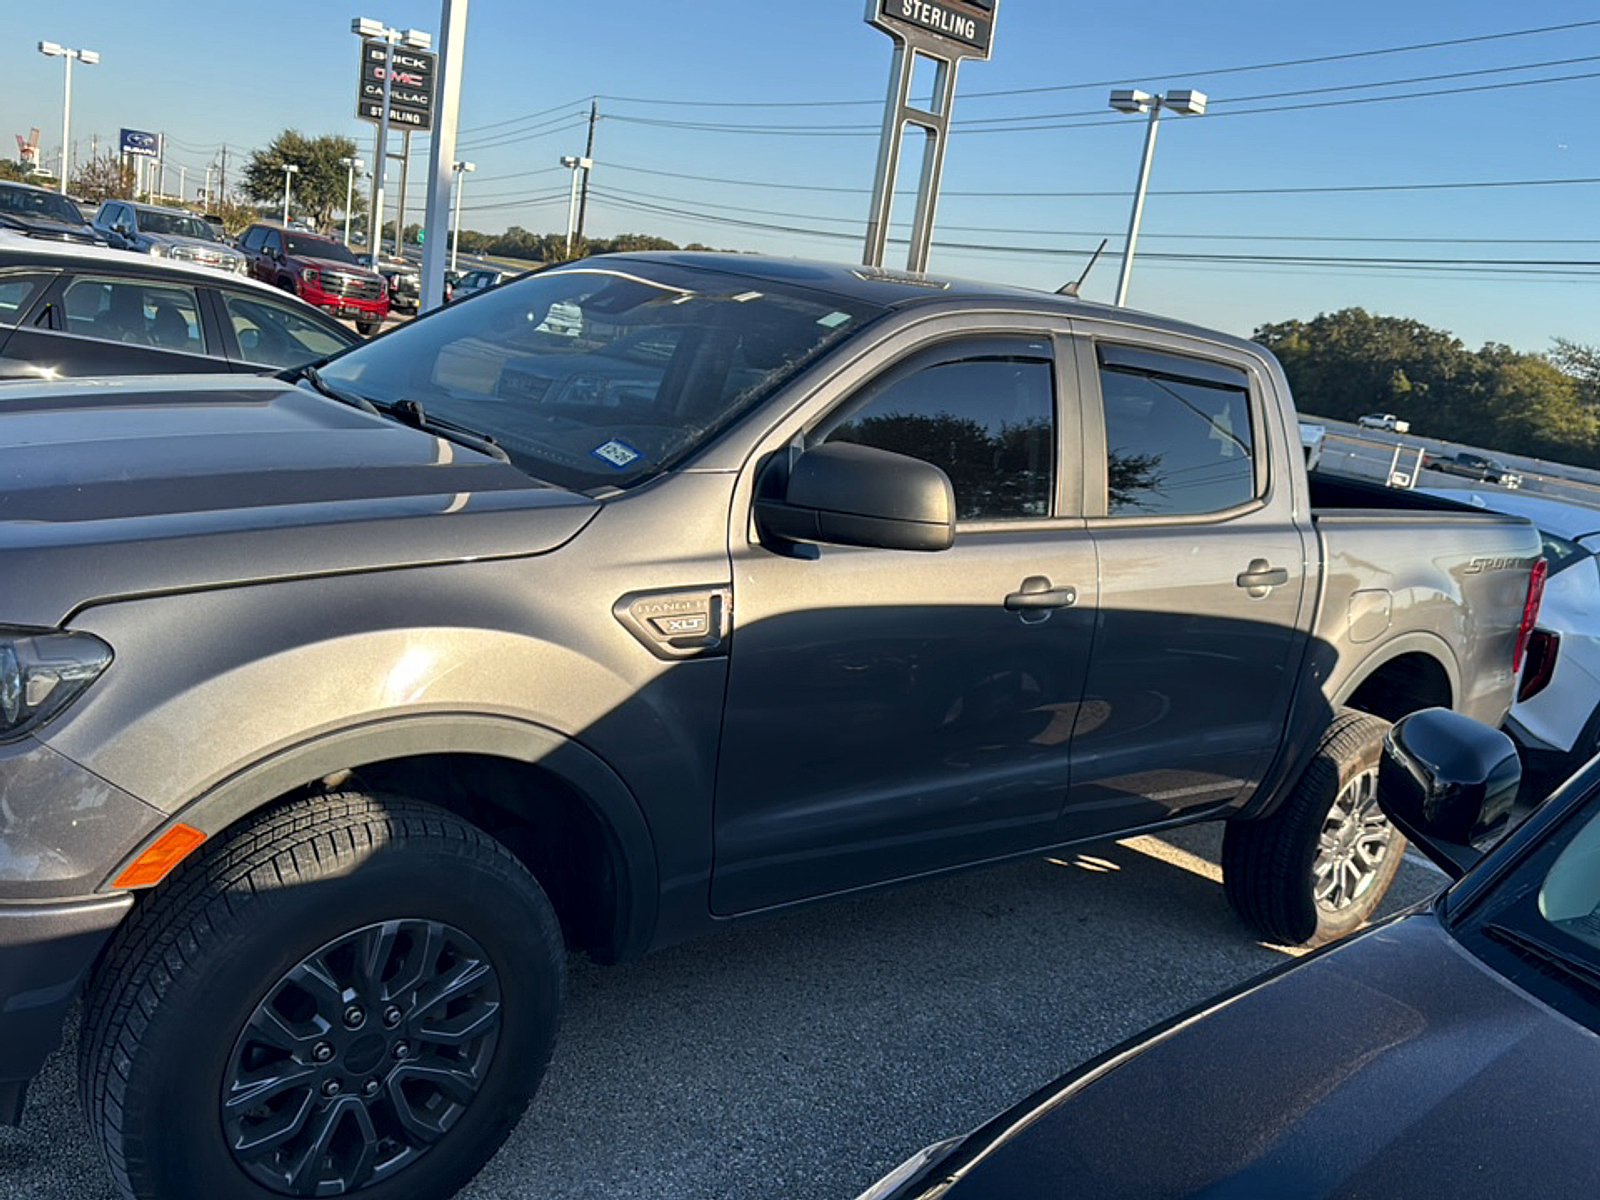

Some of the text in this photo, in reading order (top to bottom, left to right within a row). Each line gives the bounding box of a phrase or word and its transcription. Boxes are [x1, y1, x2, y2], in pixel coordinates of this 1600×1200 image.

[902, 0, 975, 39] STERLING
[365, 85, 428, 104] CAILLAC
[370, 106, 420, 124] STRLING
[669, 619, 704, 631] XLT
